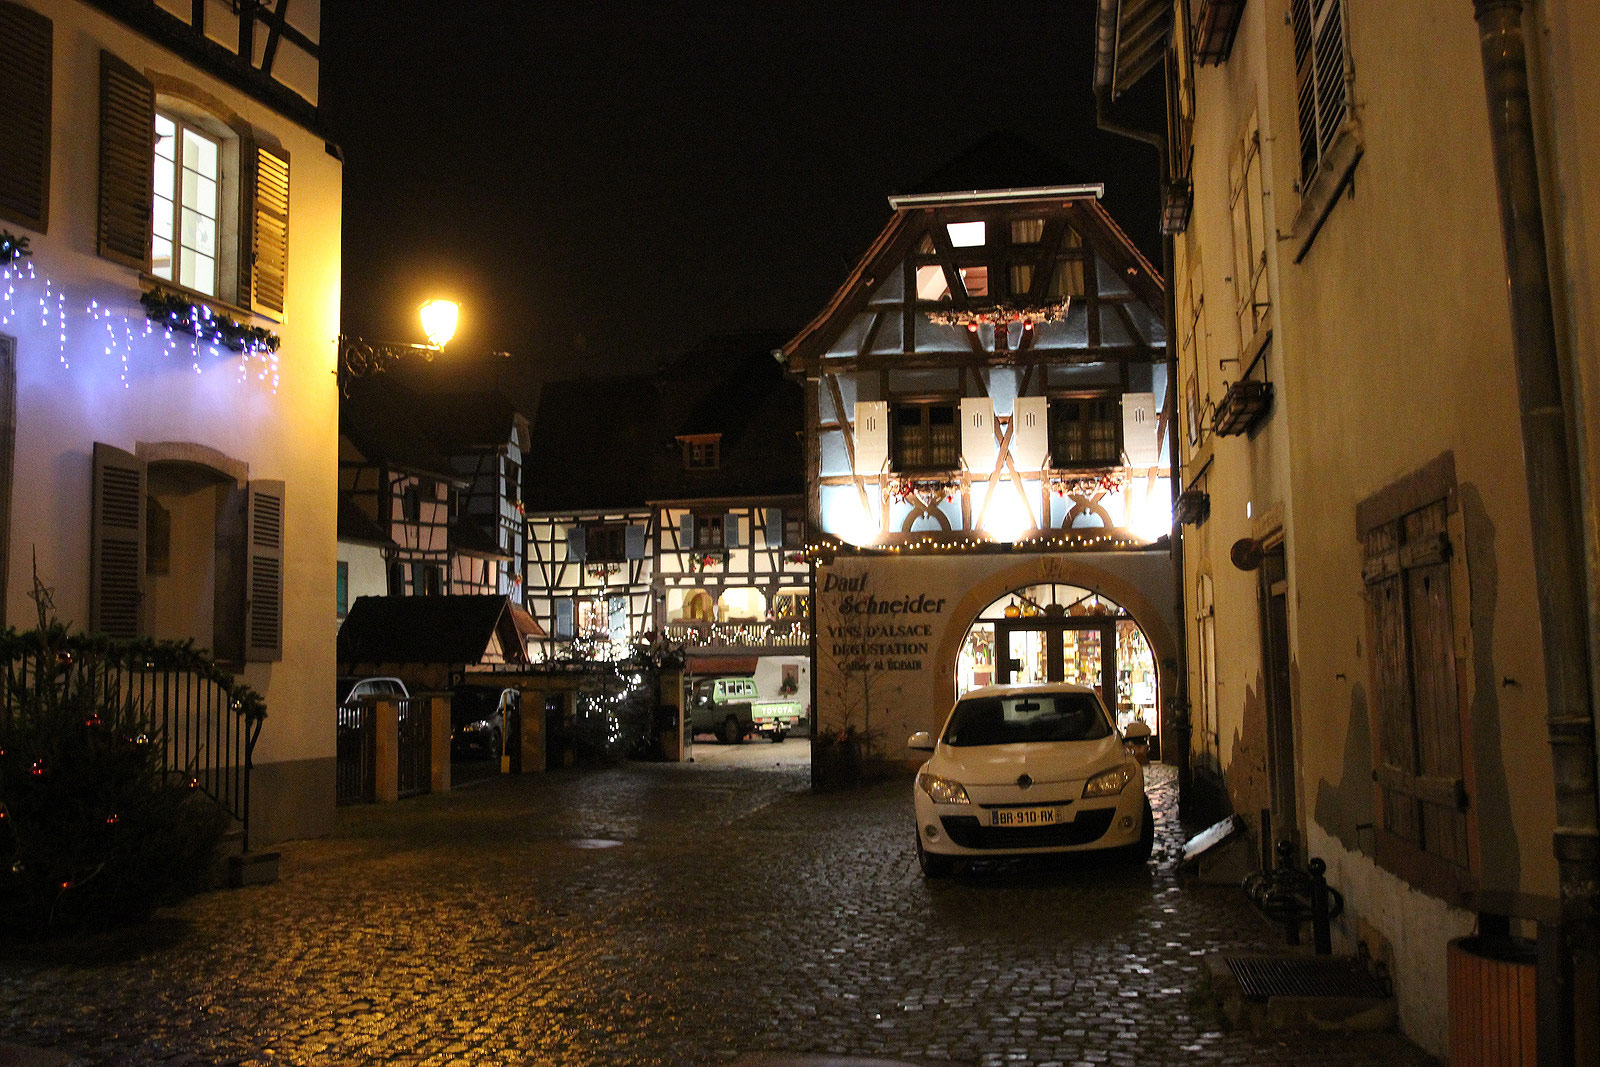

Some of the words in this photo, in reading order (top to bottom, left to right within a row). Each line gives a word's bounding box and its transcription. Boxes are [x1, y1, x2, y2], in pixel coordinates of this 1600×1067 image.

[823, 572, 868, 592] Paul
[838, 593, 946, 615] Schneider
[827, 625, 861, 638] VINS
[866, 624, 932, 638] D'ALSACE
[762, 706, 793, 715] TOYOTA
